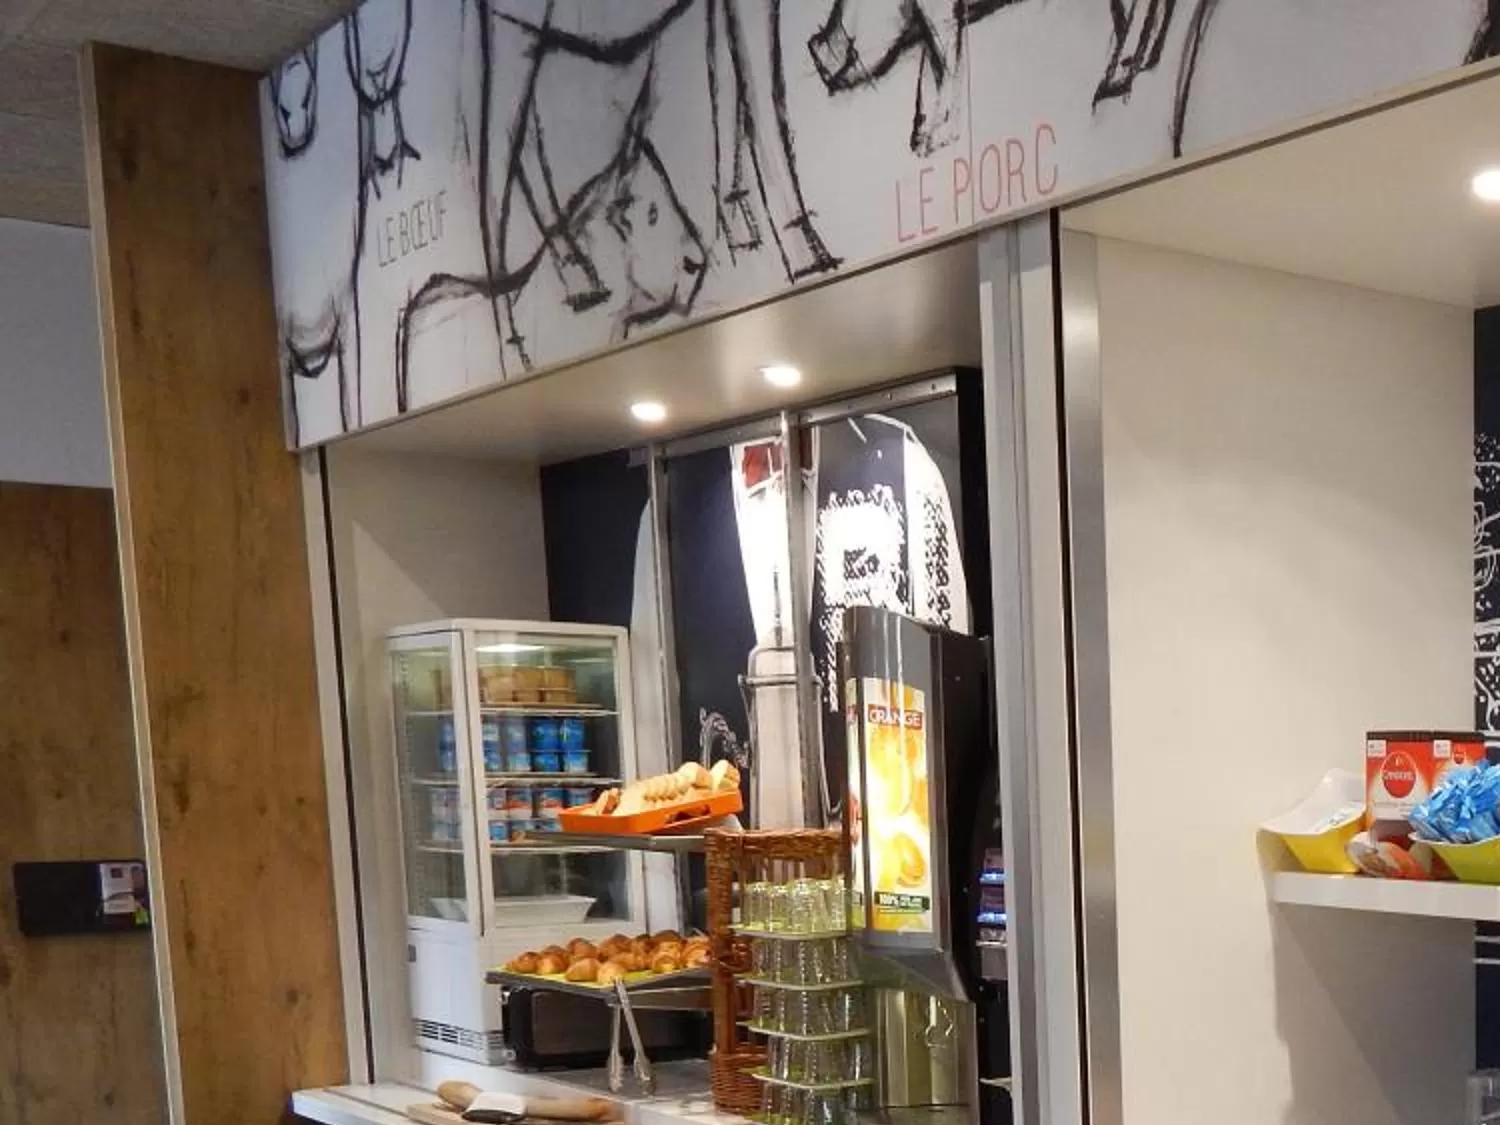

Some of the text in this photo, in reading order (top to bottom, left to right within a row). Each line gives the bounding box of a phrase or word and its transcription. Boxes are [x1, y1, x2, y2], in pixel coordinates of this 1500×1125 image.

[896, 123, 1059, 243] LE PORC
[376, 216, 397, 268] LE
